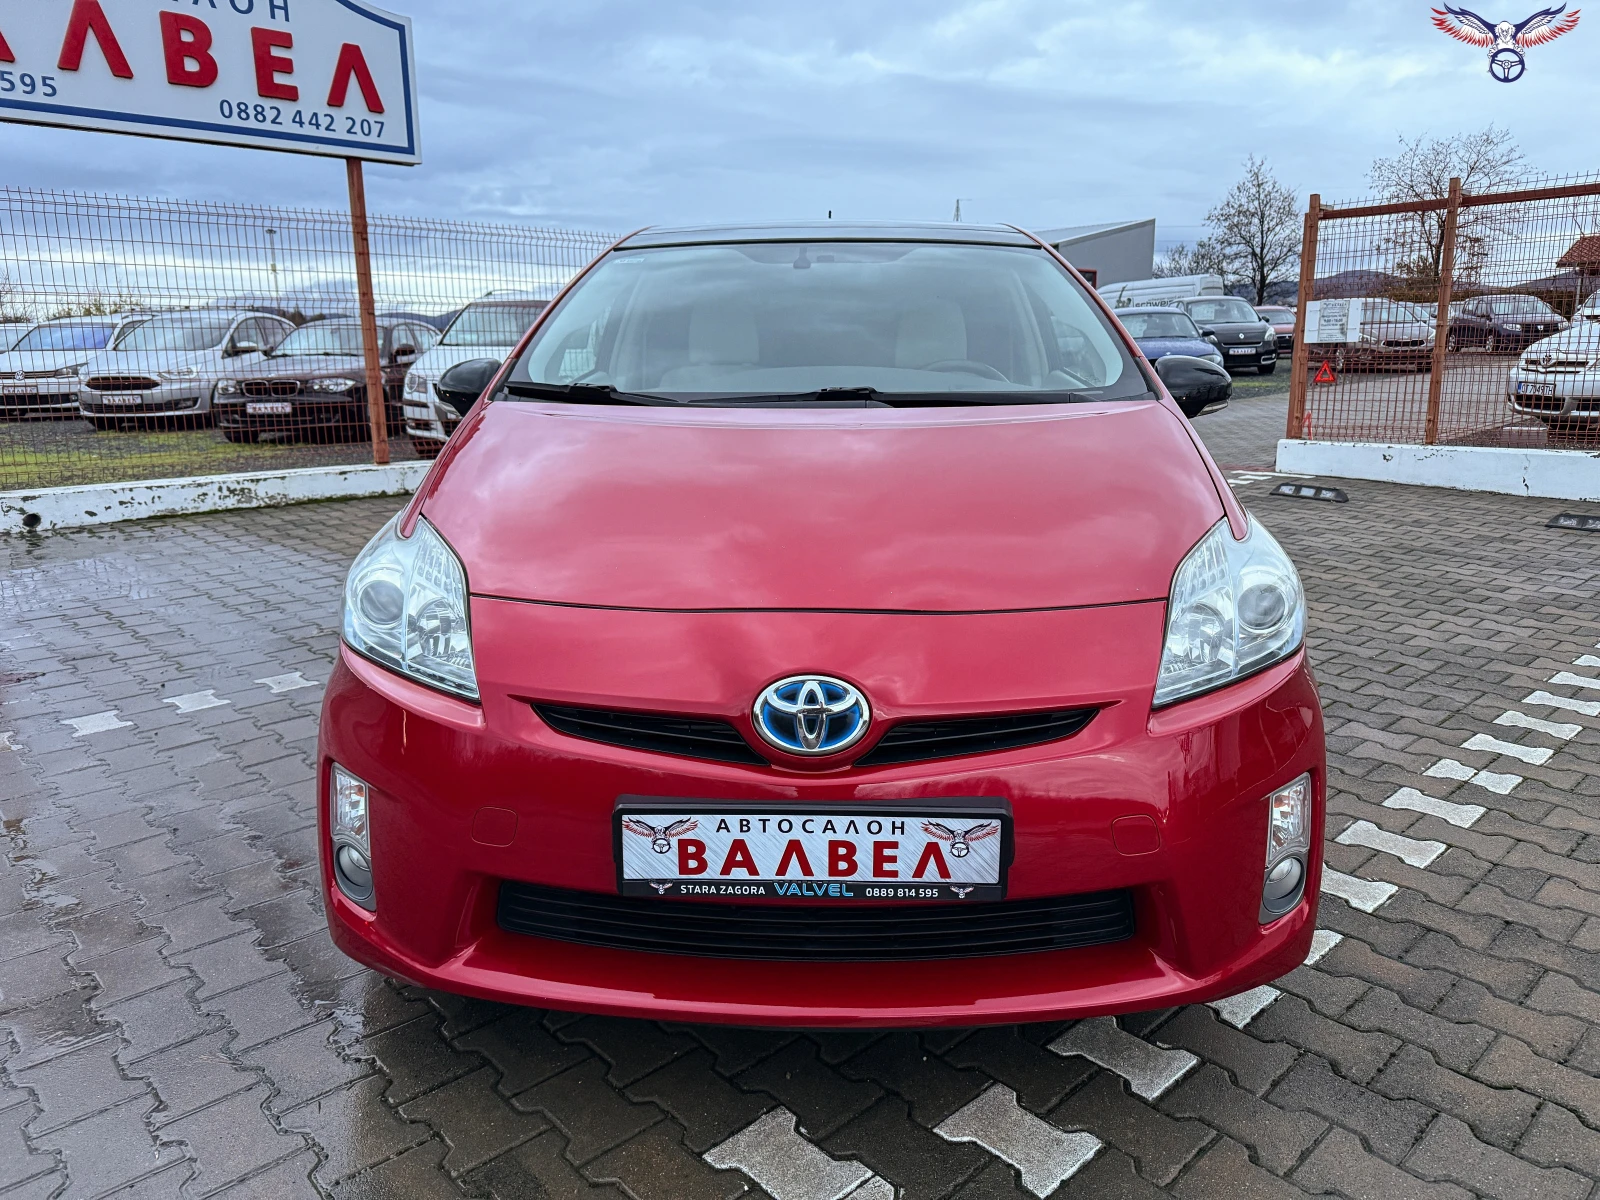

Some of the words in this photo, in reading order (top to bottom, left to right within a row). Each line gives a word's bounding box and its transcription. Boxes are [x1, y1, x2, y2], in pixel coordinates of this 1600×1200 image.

[0, 70, 57, 97] 595
[219, 99, 283, 126] 0882
[291, 109, 337, 133] 442
[345, 116, 385, 138] 207
[715, 817, 906, 836] АВТОСАЛОН
[680, 884, 717, 895] STARA
[720, 884, 766, 896] ZAGORA
[773, 881, 854, 898] VALVEL
[865, 887, 895, 898] 0889
[897, 887, 917, 898] 814
[918, 888, 939, 898] 595
